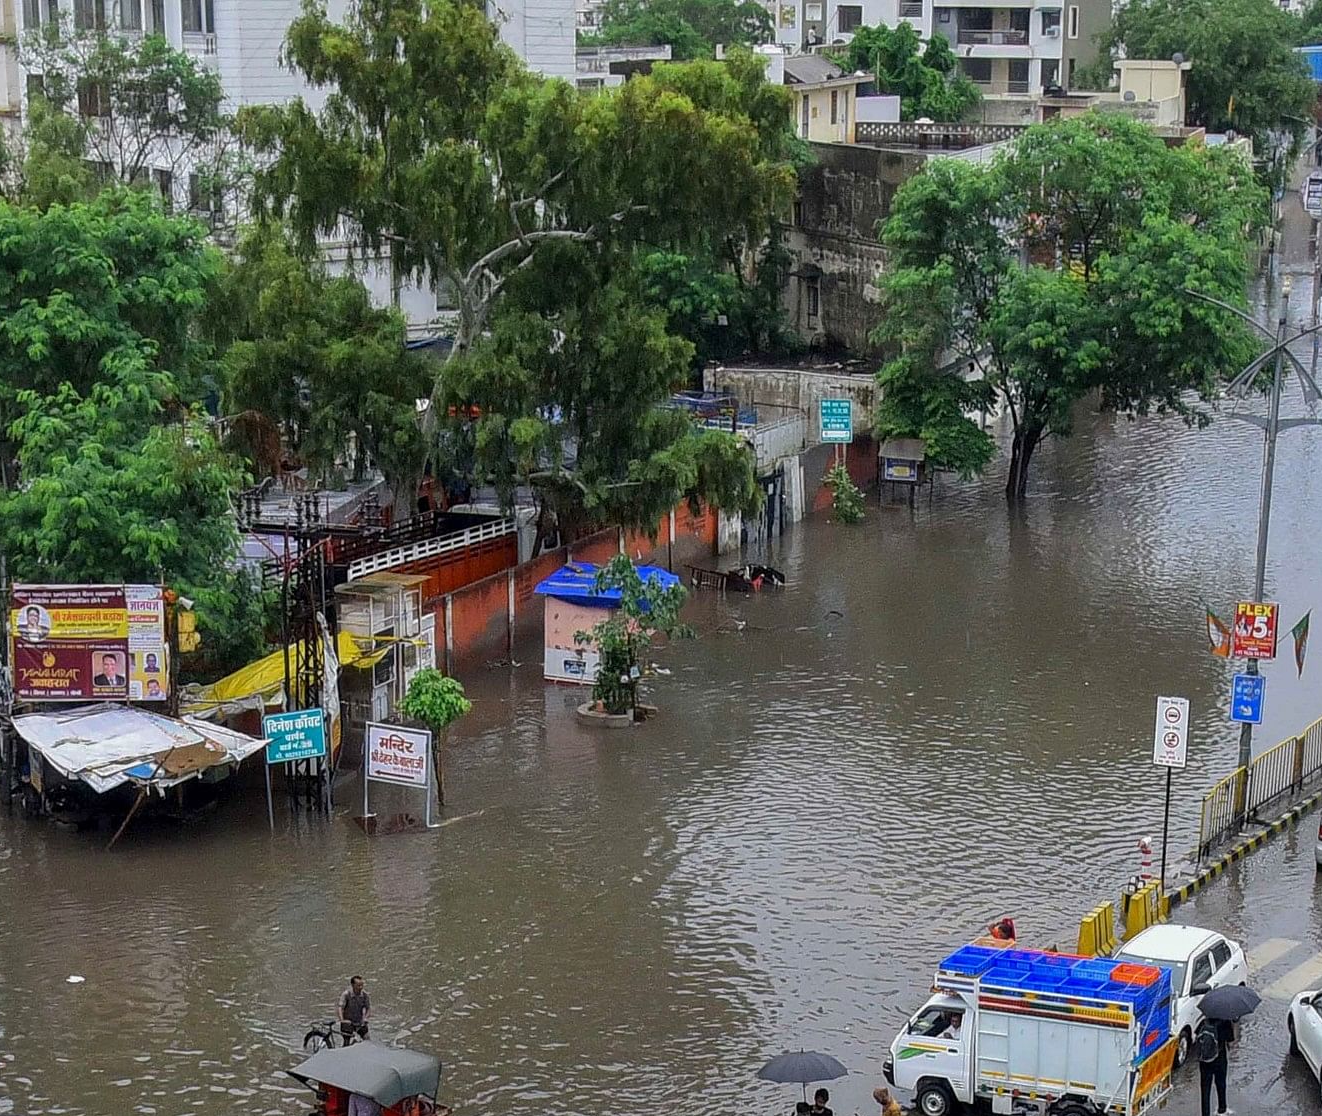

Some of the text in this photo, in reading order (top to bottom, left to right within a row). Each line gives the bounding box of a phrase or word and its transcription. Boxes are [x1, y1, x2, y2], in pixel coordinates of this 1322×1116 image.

[1238, 604, 1272, 617] FLEX
[1253, 616, 1268, 639] 5
[266, 717, 294, 734] दिनेश
[378, 734, 415, 754] मन्दिर
